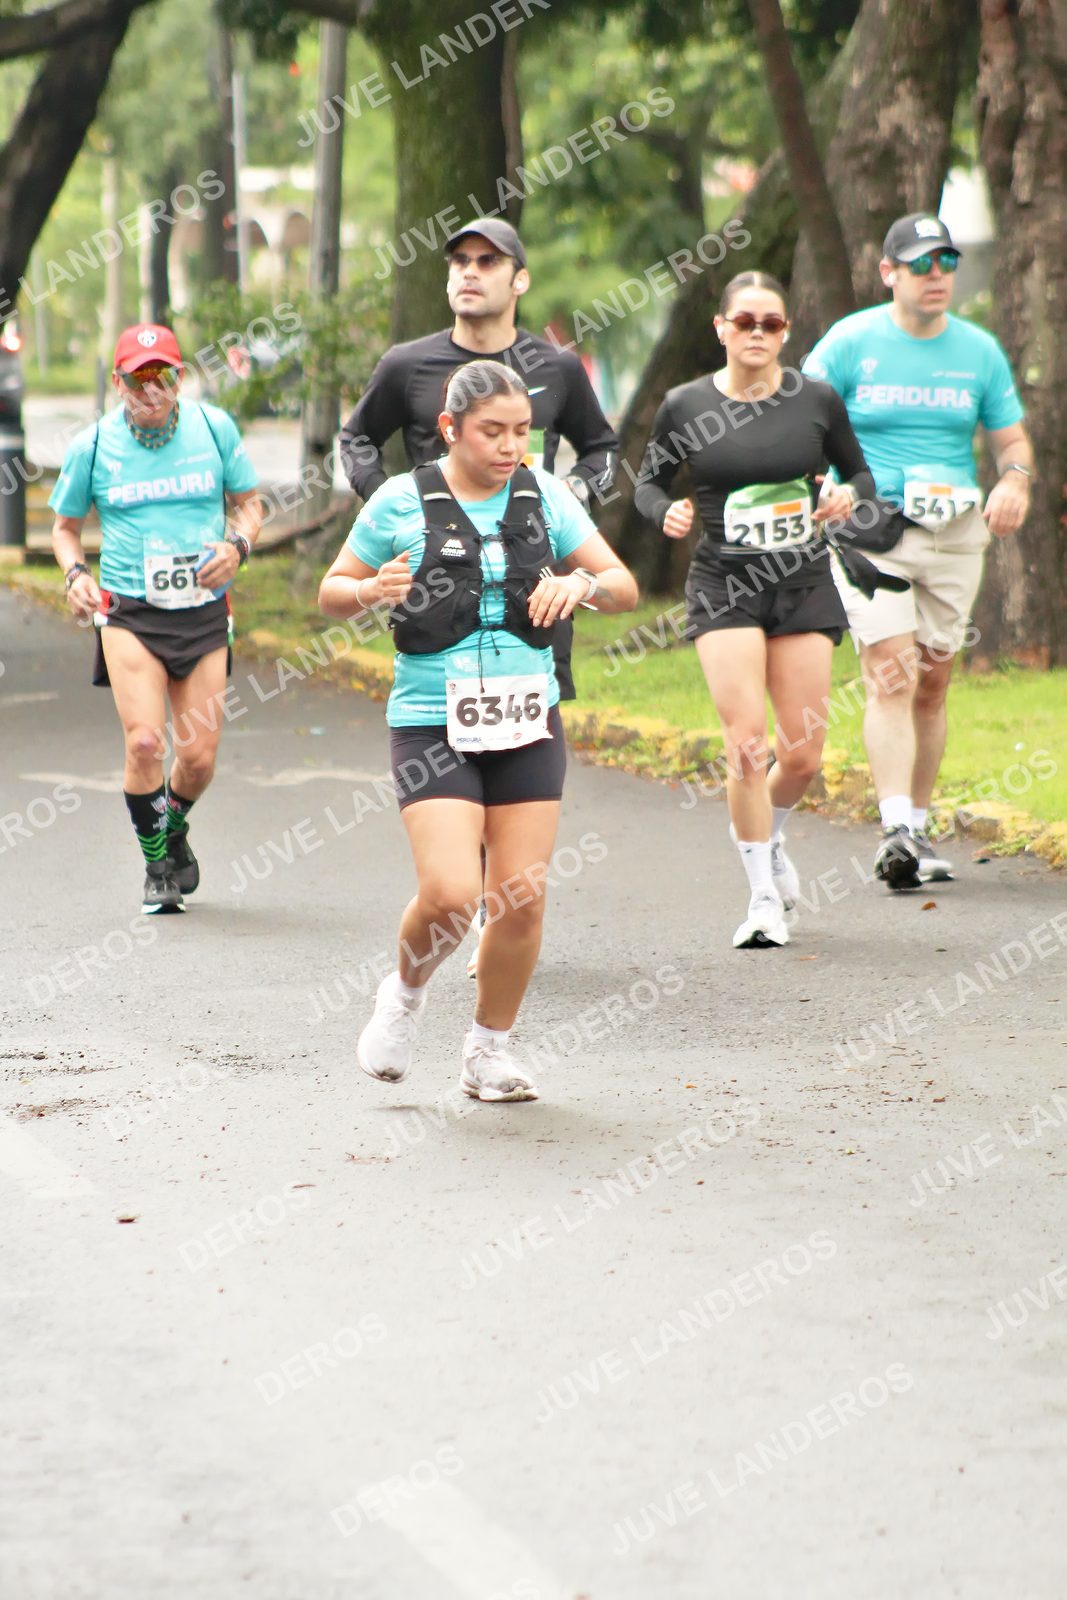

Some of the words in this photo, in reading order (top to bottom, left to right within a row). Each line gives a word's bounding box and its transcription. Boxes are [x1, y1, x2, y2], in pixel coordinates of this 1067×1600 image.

[855, 385, 973, 409] PERDURA
[107, 470, 216, 504] PERDURA
[732, 513, 805, 546] 2153
[456, 692, 542, 728] 6346
